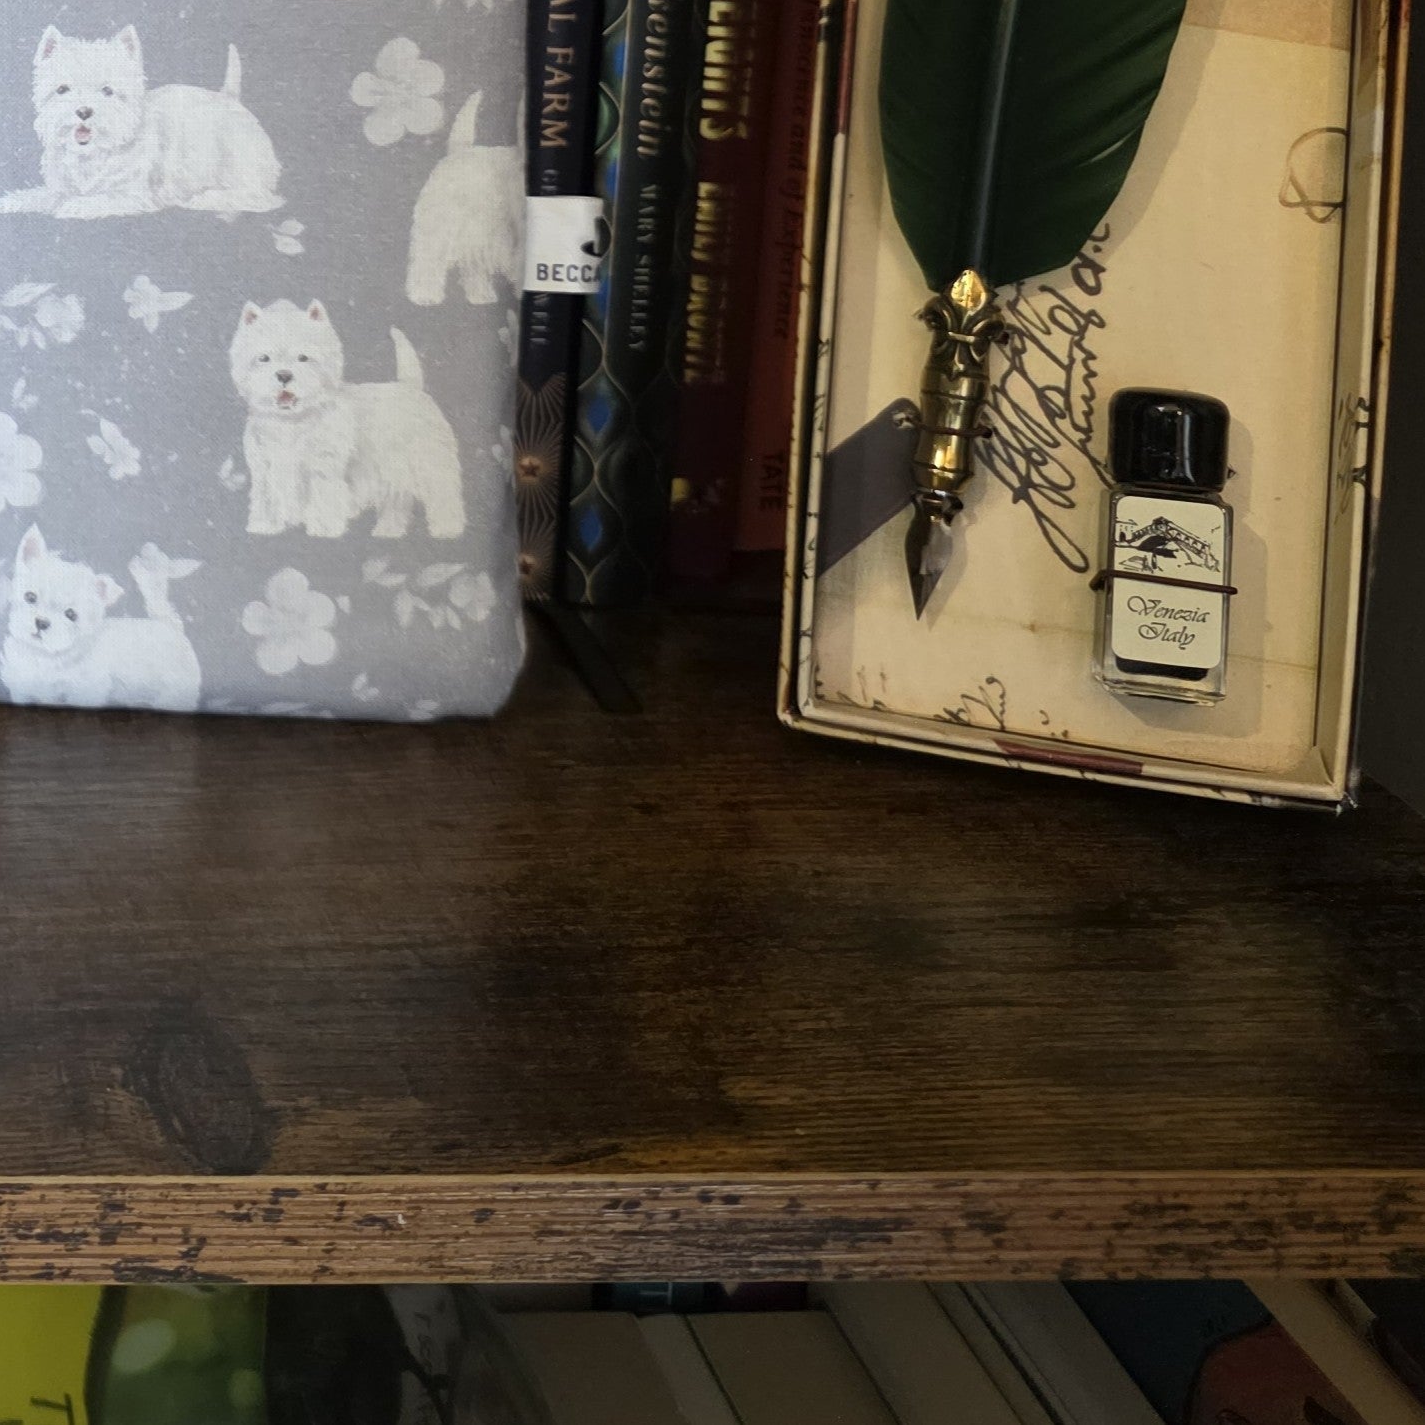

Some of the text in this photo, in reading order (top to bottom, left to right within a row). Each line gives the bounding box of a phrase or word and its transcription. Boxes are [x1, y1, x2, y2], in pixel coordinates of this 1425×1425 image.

[539, 47, 575, 149] FARM
[759, 452, 785, 511] TATE
[1127, 595, 1211, 623] Venezia
[1138, 621, 1196, 650] Italy
